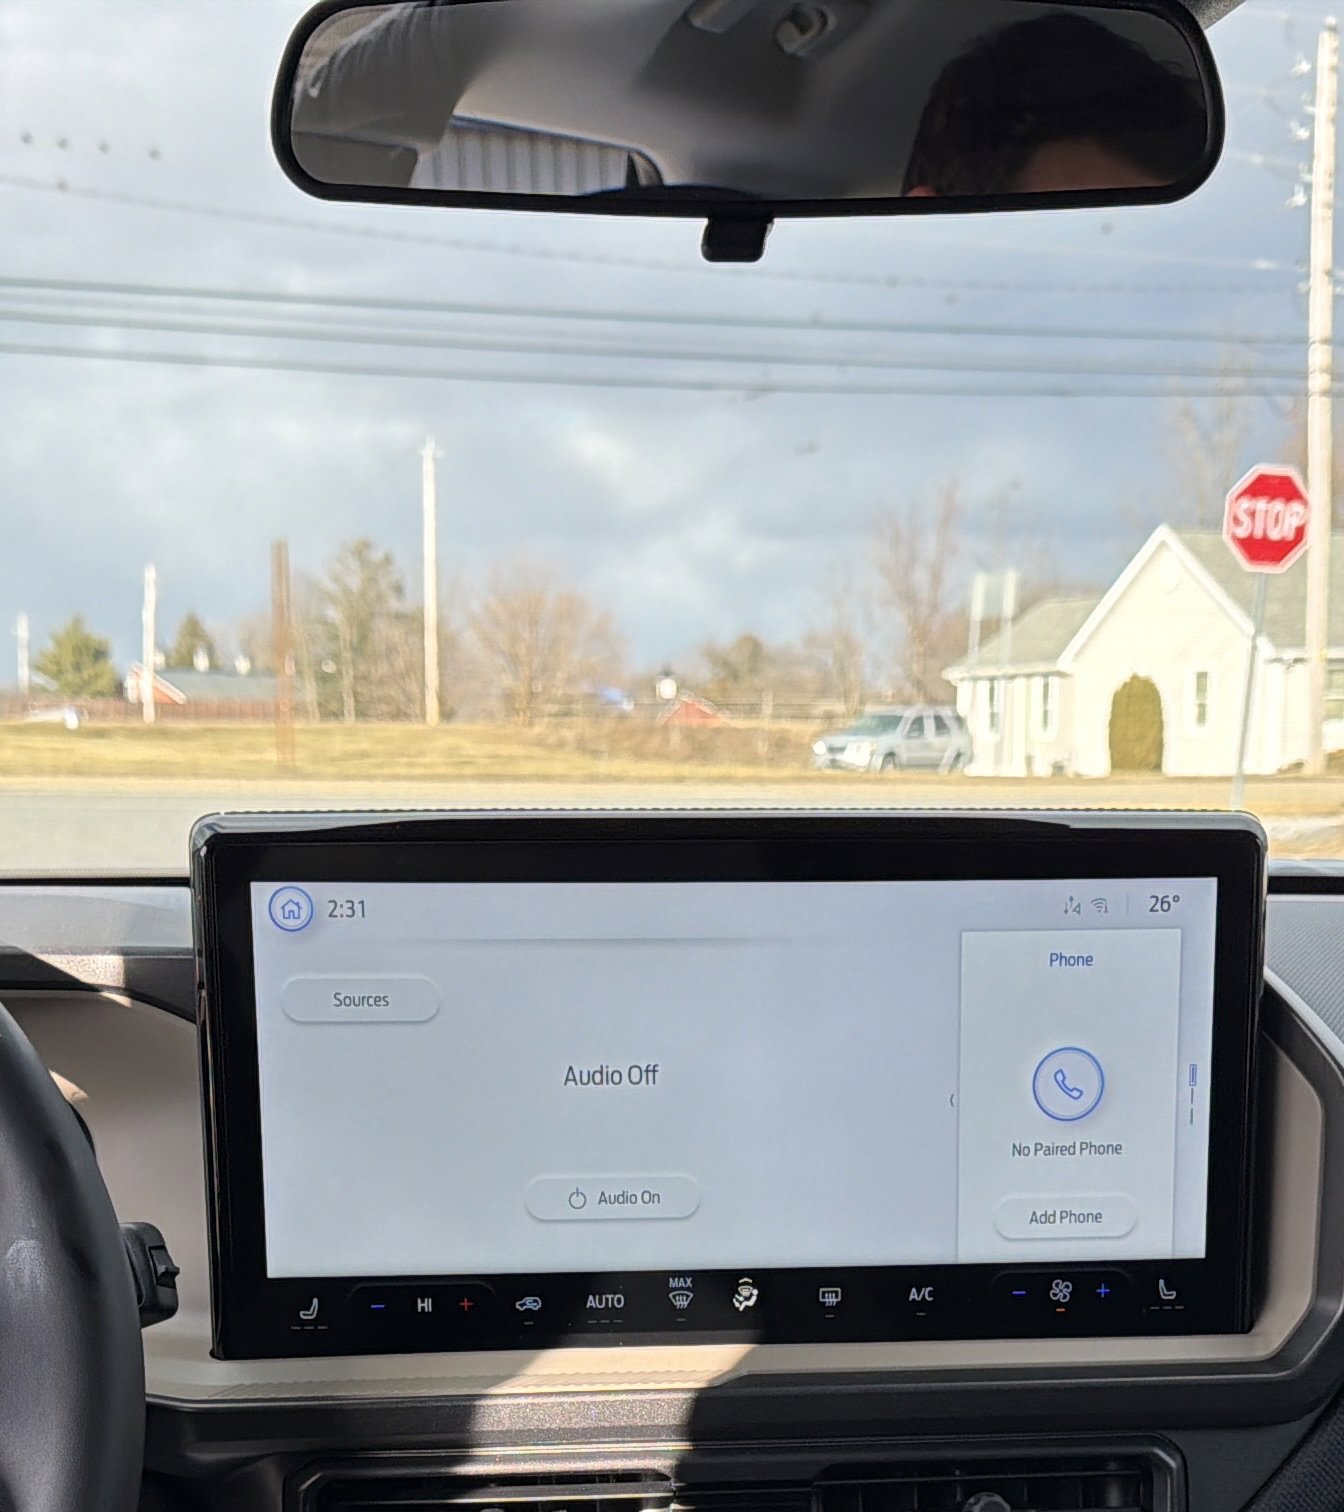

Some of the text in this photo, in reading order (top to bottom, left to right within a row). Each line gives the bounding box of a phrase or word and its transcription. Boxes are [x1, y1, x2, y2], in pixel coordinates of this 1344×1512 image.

[1231, 496, 1307, 541] STOP
[327, 899, 366, 919] 2:31
[1148, 894, 1181, 913] 26°
[1049, 952, 1094, 968] Phone
[333, 992, 390, 1008] Sources
[563, 1063, 660, 1086] Audio Off
[1011, 1140, 1123, 1157] No Paired Phone
[597, 1189, 661, 1206] Audio On
[1029, 1209, 1103, 1225] Add Phone
[669, 1277, 693, 1288] MAX
[908, 1286, 934, 1301] A/C
[417, 1297, 433, 1313] HI
[585, 1294, 625, 1310] AUTO
